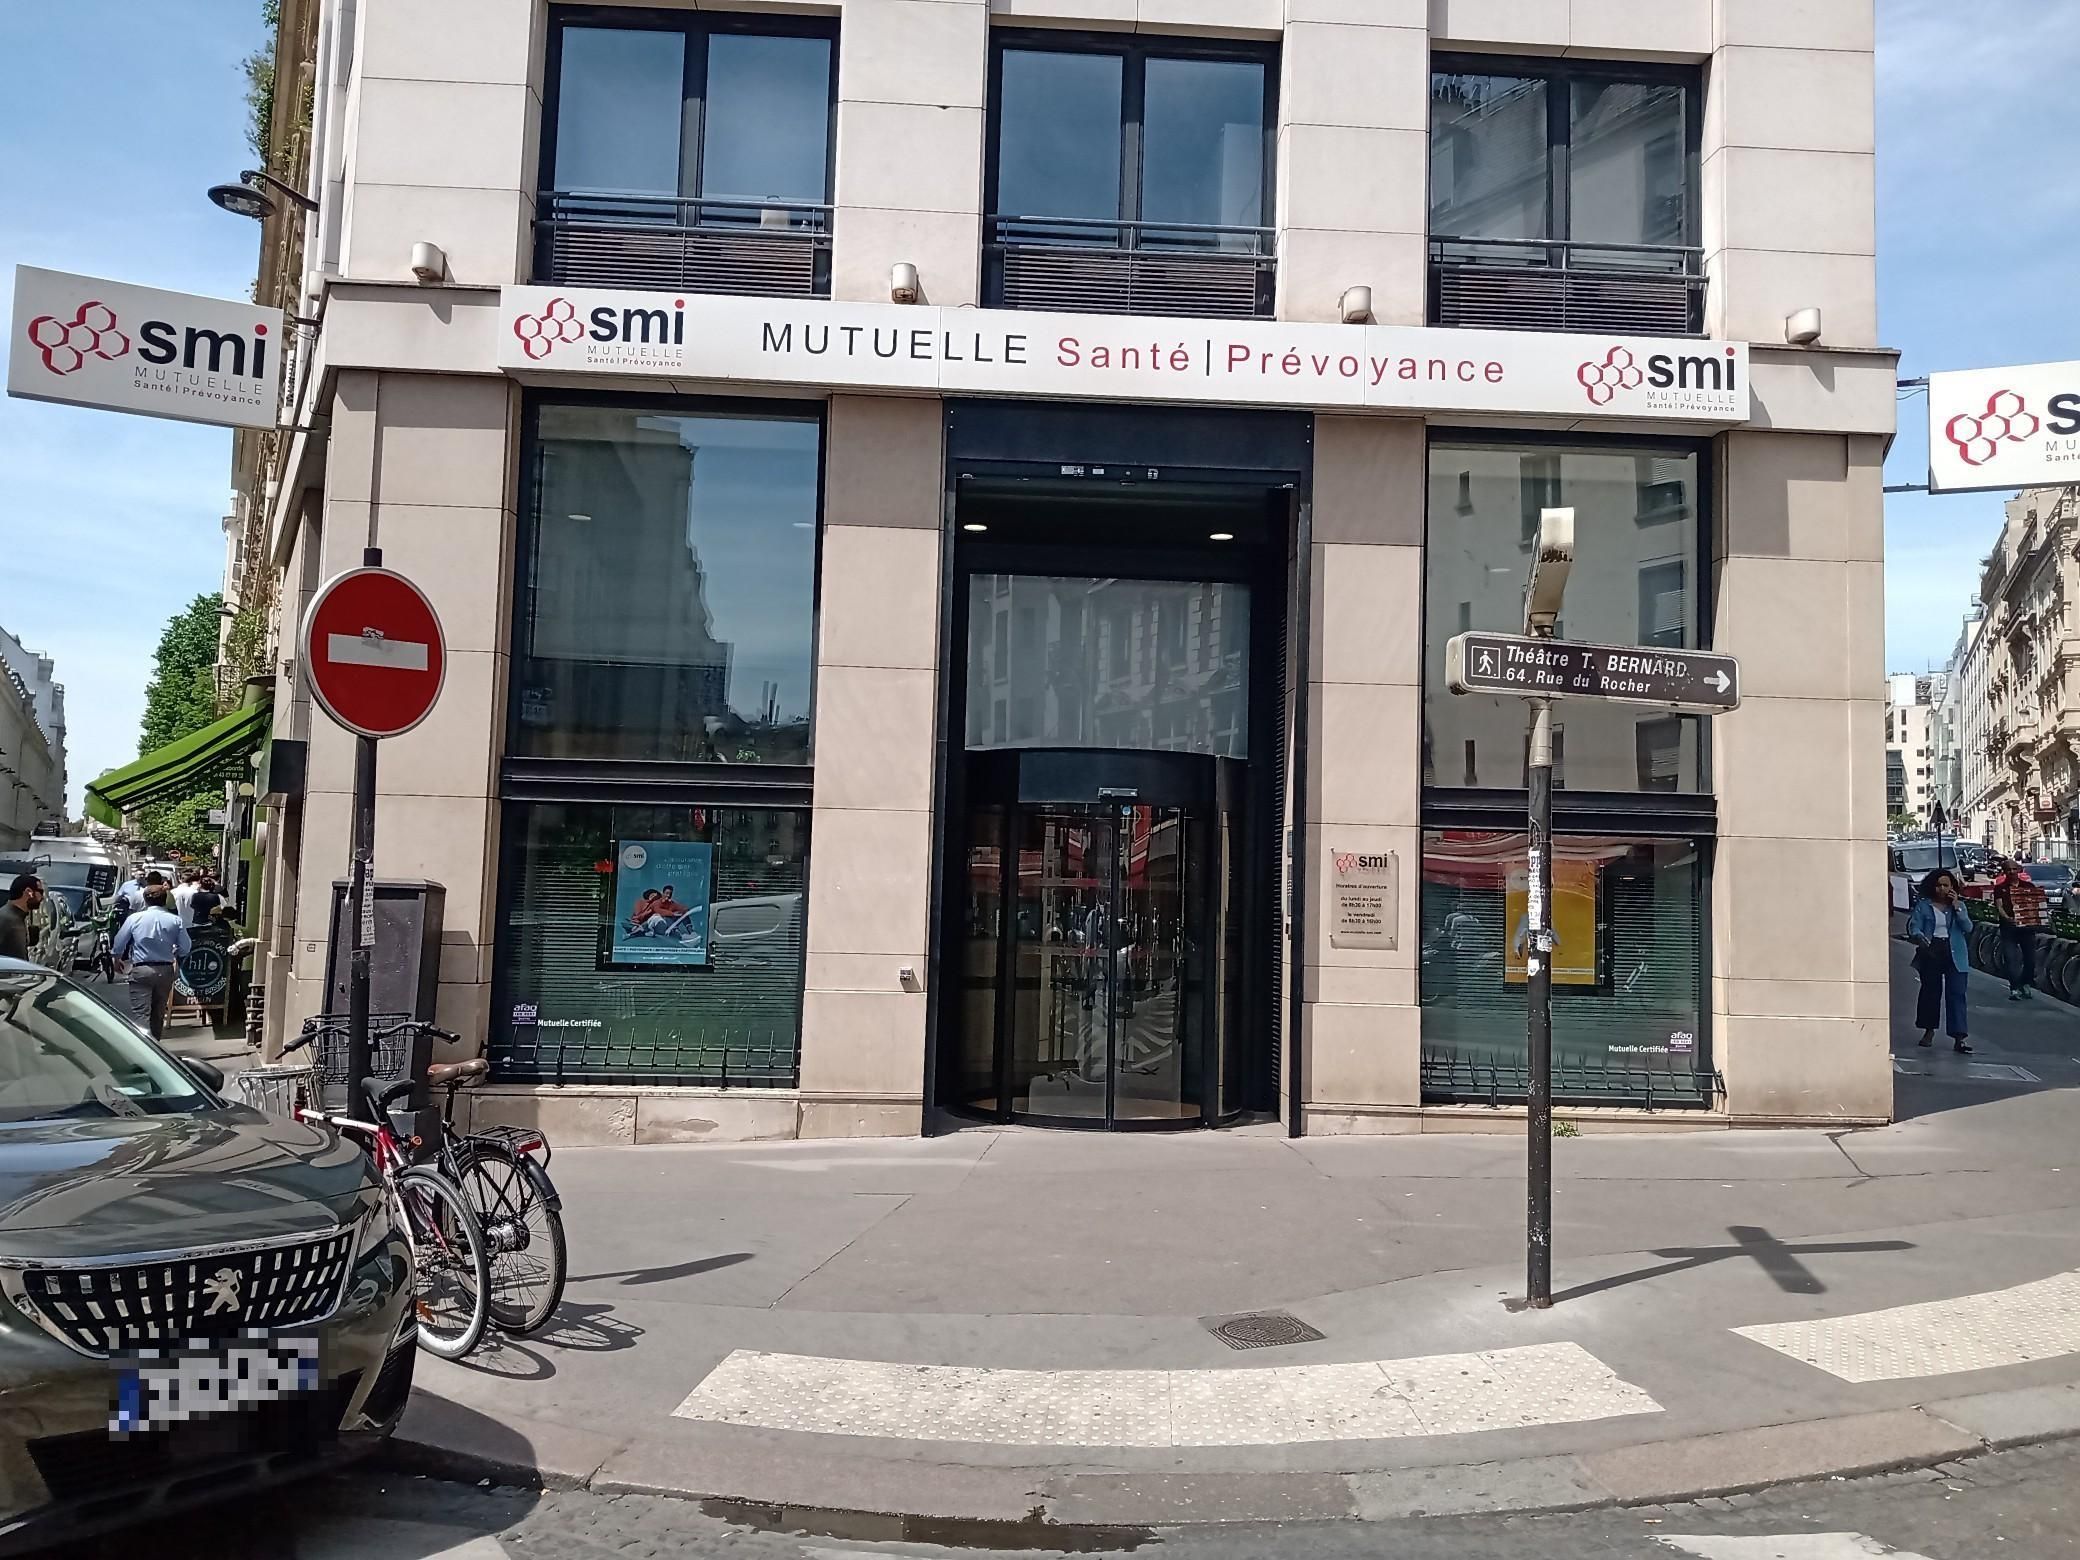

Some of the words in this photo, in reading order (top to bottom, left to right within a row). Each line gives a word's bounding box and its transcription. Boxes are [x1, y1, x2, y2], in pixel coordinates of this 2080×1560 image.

[588, 298, 685, 345] smi
[137, 320, 268, 379] smi
[587, 345, 683, 359] MUTUELLE
[762, 322, 1027, 365] MUTUELLE
[1057, 336, 1191, 372] Santé
[1227, 344, 1506, 386] Prévoyance
[135, 366, 263, 395] MUTUELLE
[1647, 346, 1735, 390] smi
[1646, 391, 1735, 404] MUTUELLE
[1506, 646, 1570, 667] Théâtre
[1581, 652, 1595, 670] T.
[1505, 667, 1533, 684] 64,
[1536, 671, 1563, 686] Rue
[1573, 673, 1590, 688] du
[1600, 677, 1651, 694] Rocher
[1358, 853, 1388, 868] smi
[537, 1019, 569, 1027] Mutuelle
[570, 1019, 602, 1027] Certifiée
[1608, 1045, 1638, 1053] Mutuelle
[1639, 1045, 1669, 1053] Certifiée
